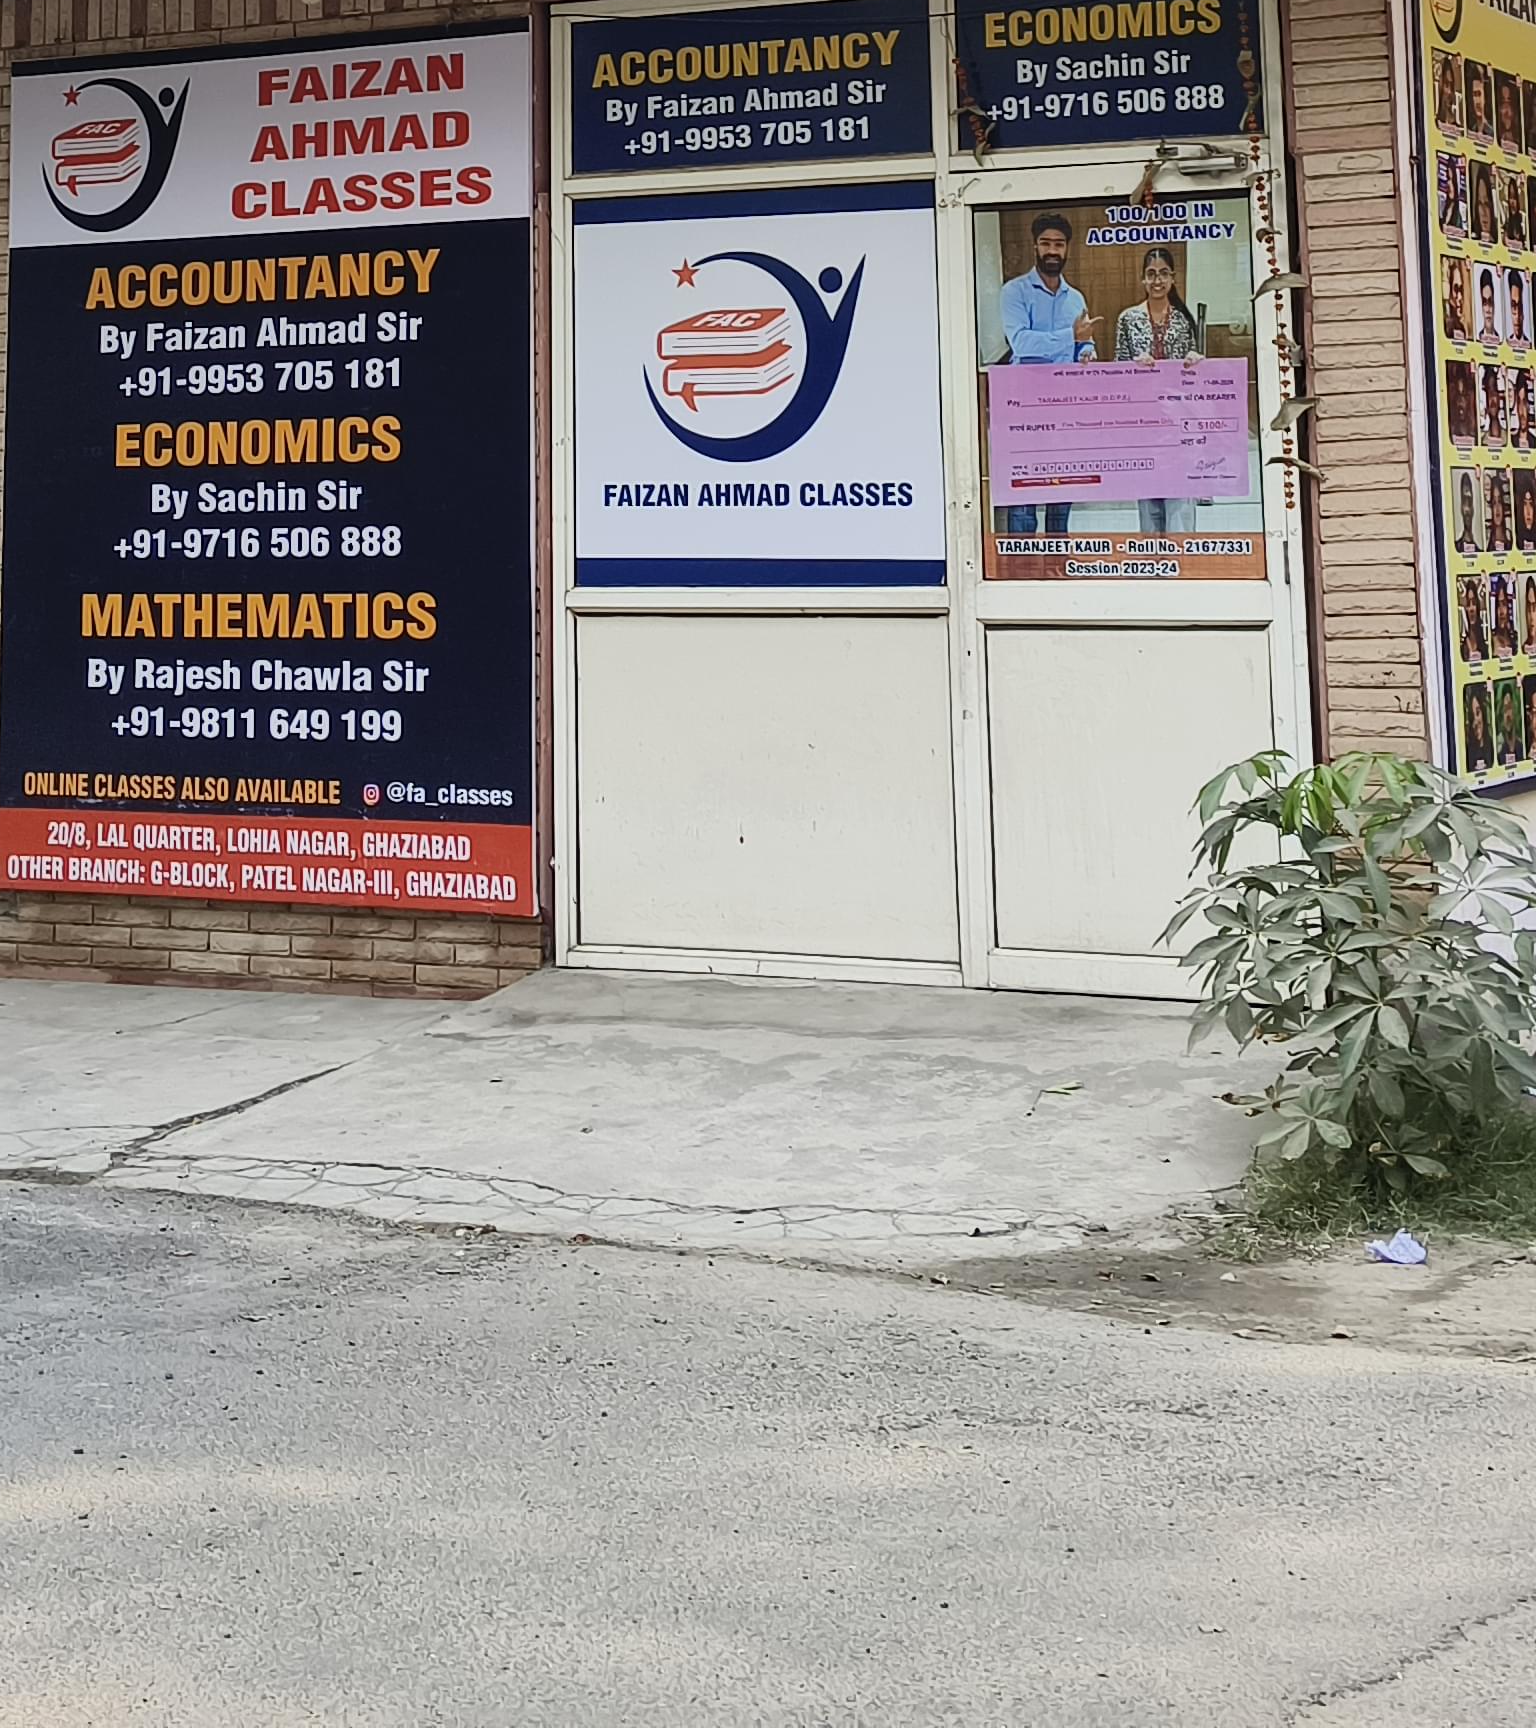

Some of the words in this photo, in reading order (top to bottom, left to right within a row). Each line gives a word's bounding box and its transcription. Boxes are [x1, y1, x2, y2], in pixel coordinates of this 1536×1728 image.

[591, 29, 901, 89] ACCOUNTANCY
[1016, 59, 1049, 88] By
[1055, 53, 1145, 81] Sachin
[1153, 49, 1191, 75] Sir
[258, 53, 464, 106] FAIZAN
[606, 99, 639, 126] By
[647, 93, 735, 120] Faizan
[743, 82, 838, 113] Ahmad
[847, 79, 887, 105] Sir
[986, 91, 1109, 121] +91-9716
[1117, 87, 1166, 115] 506
[1175, 84, 1225, 110] 888
[76, 121, 121, 136] FAC
[250, 112, 470, 163] AHMAD
[624, 124, 752, 155] +91-9953
[759, 120, 812, 146] 705
[820, 115, 870, 143] 181
[231, 166, 493, 220] CLASSES
[1106, 204, 1187, 223] 100/100
[1193, 202, 1214, 218] IN
[1087, 223, 1236, 244] ACCOUNTANCY
[85, 248, 440, 310] ACCOUNTANCY
[100, 325, 135, 359] By
[146, 321, 246, 353] Faizan
[256, 314, 366, 349] Ahmad
[377, 311, 423, 342] Sir
[692, 312, 762, 328] FAC
[120, 363, 263, 398] +91-9953
[274, 359, 334, 392] 705
[345, 357, 401, 388] 181
[115, 415, 402, 468] ECONOMICS
[151, 484, 188, 519] By
[198, 482, 306, 513] Sachin
[316, 480, 362, 511] Sir
[603, 483, 689, 507] FAIZAN
[697, 483, 790, 507] AHMAD
[799, 482, 913, 507] CLASSES
[113, 528, 259, 560] +91-9716
[269, 527, 330, 557] 506
[340, 525, 402, 558] 888
[997, 540, 1071, 553] TARANJEET
[1075, 540, 1111, 553] KAUR
[1128, 540, 1154, 553] Roll
[1158, 540, 1181, 553] No.
[1185, 540, 1252, 553] 21677331
[1067, 561, 1119, 575] Session
[1123, 561, 1177, 575] 2023-24
[81, 592, 438, 640] MATHEMATICS
[87, 659, 125, 695] By
[134, 658, 241, 697] Rajesh
[251, 660, 373, 693] Chawla
[382, 661, 430, 693] Sir
[111, 707, 255, 739] +91-9811
[269, 709, 330, 741] 649
[340, 710, 403, 742] 199
[24, 772, 89, 798] ONLINE
[94, 773, 176, 801] CLASSES
[180, 777, 232, 803] ALSO
[235, 778, 341, 805] AVAILABLE
[386, 781, 514, 808] @fa_classes
[47, 821, 92, 850] 20/8,
[96, 824, 131, 848] LAL
[133, 825, 222, 857] QUARTER,
[227, 829, 281, 854] LOHIA
[286, 830, 358, 860] NAGAR,
[361, 832, 471, 861] GHAZIABAD
[7, 854, 64, 880] OTHER
[68, 857, 146, 885] BRANCH:
[150, 862, 236, 893] G-BLOCK,
[240, 865, 297, 891] PATEL
[302, 867, 401, 901] NAGAR-III,
[406, 872, 516, 902] GHAZIABAD
